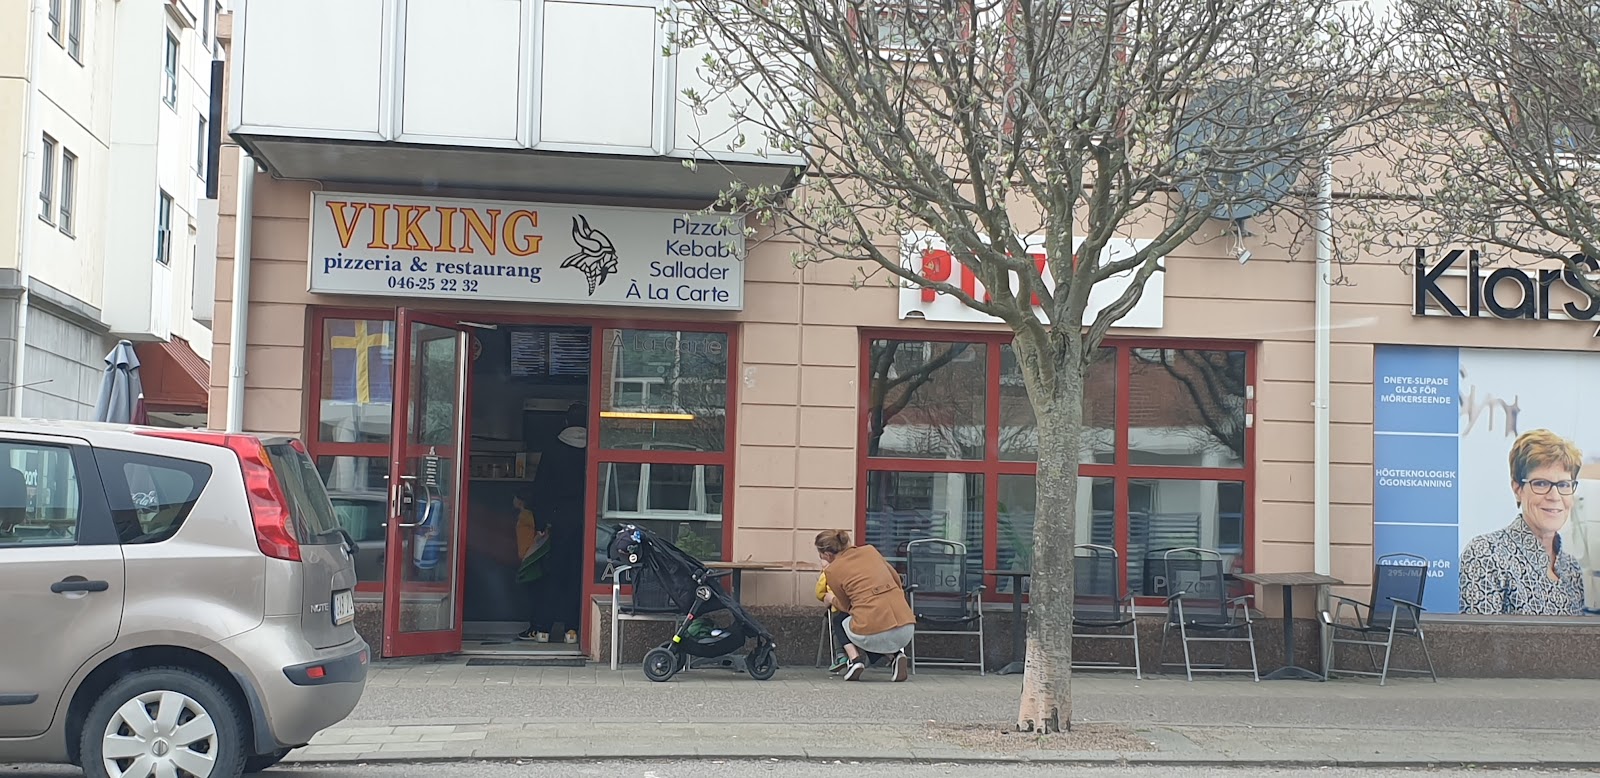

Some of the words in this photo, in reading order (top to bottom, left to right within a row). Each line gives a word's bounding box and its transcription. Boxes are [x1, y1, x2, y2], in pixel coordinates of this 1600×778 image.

[325, 201, 543, 257] VIKING
[666, 239, 730, 259] Kebab
[323, 252, 402, 274] pizzeria
[409, 256, 428, 272] &
[435, 261, 543, 284] restaurang
[649, 260, 730, 280] Sallader
[387, 275, 435, 291] 046-25
[440, 278, 458, 292] 22
[461, 279, 479, 293] 32
[625, 278, 642, 299] À
[648, 283, 669, 300] La
[676, 284, 730, 303] Carte
[633, 335, 657, 353] La
[1383, 376, 1449, 386] DNEYE-SLIPADE
[1395, 386, 1418, 394] GLAS
[1419, 385, 1437, 395] FÖR
[1381, 394, 1451, 404] MÖRKERSEENDE
[1376, 468, 1456, 479] HÖGTEKNOLOGISK
[1379, 477, 1452, 488] ÖGONSKANNING
[1432, 558, 1451, 569] FÖR
[310, 602, 329, 614] NOTE
